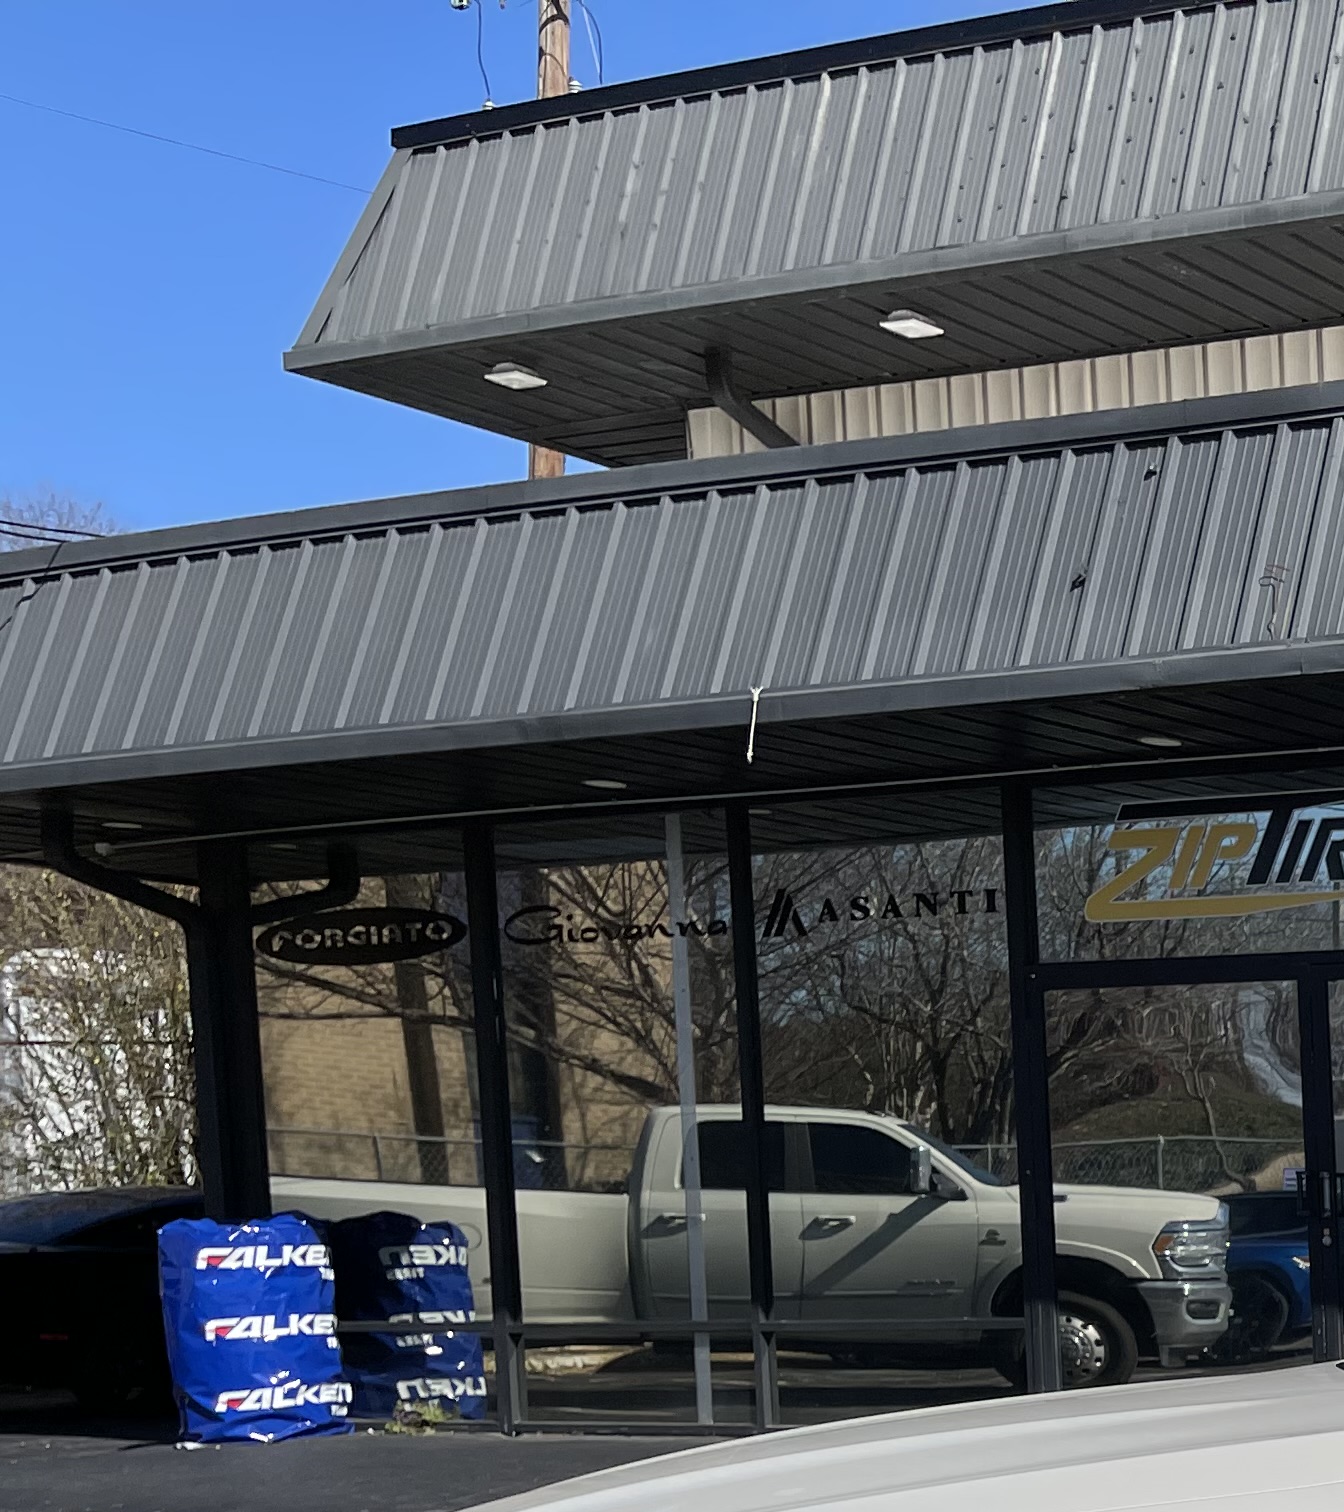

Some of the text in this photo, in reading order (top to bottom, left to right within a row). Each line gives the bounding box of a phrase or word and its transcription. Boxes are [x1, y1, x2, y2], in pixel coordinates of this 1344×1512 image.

[271, 919, 453, 952] FORGIATO
[503, 904, 728, 945] Giovanna
[195, 1244, 332, 1271] FALKE
[204, 1313, 338, 1342] FALKE
